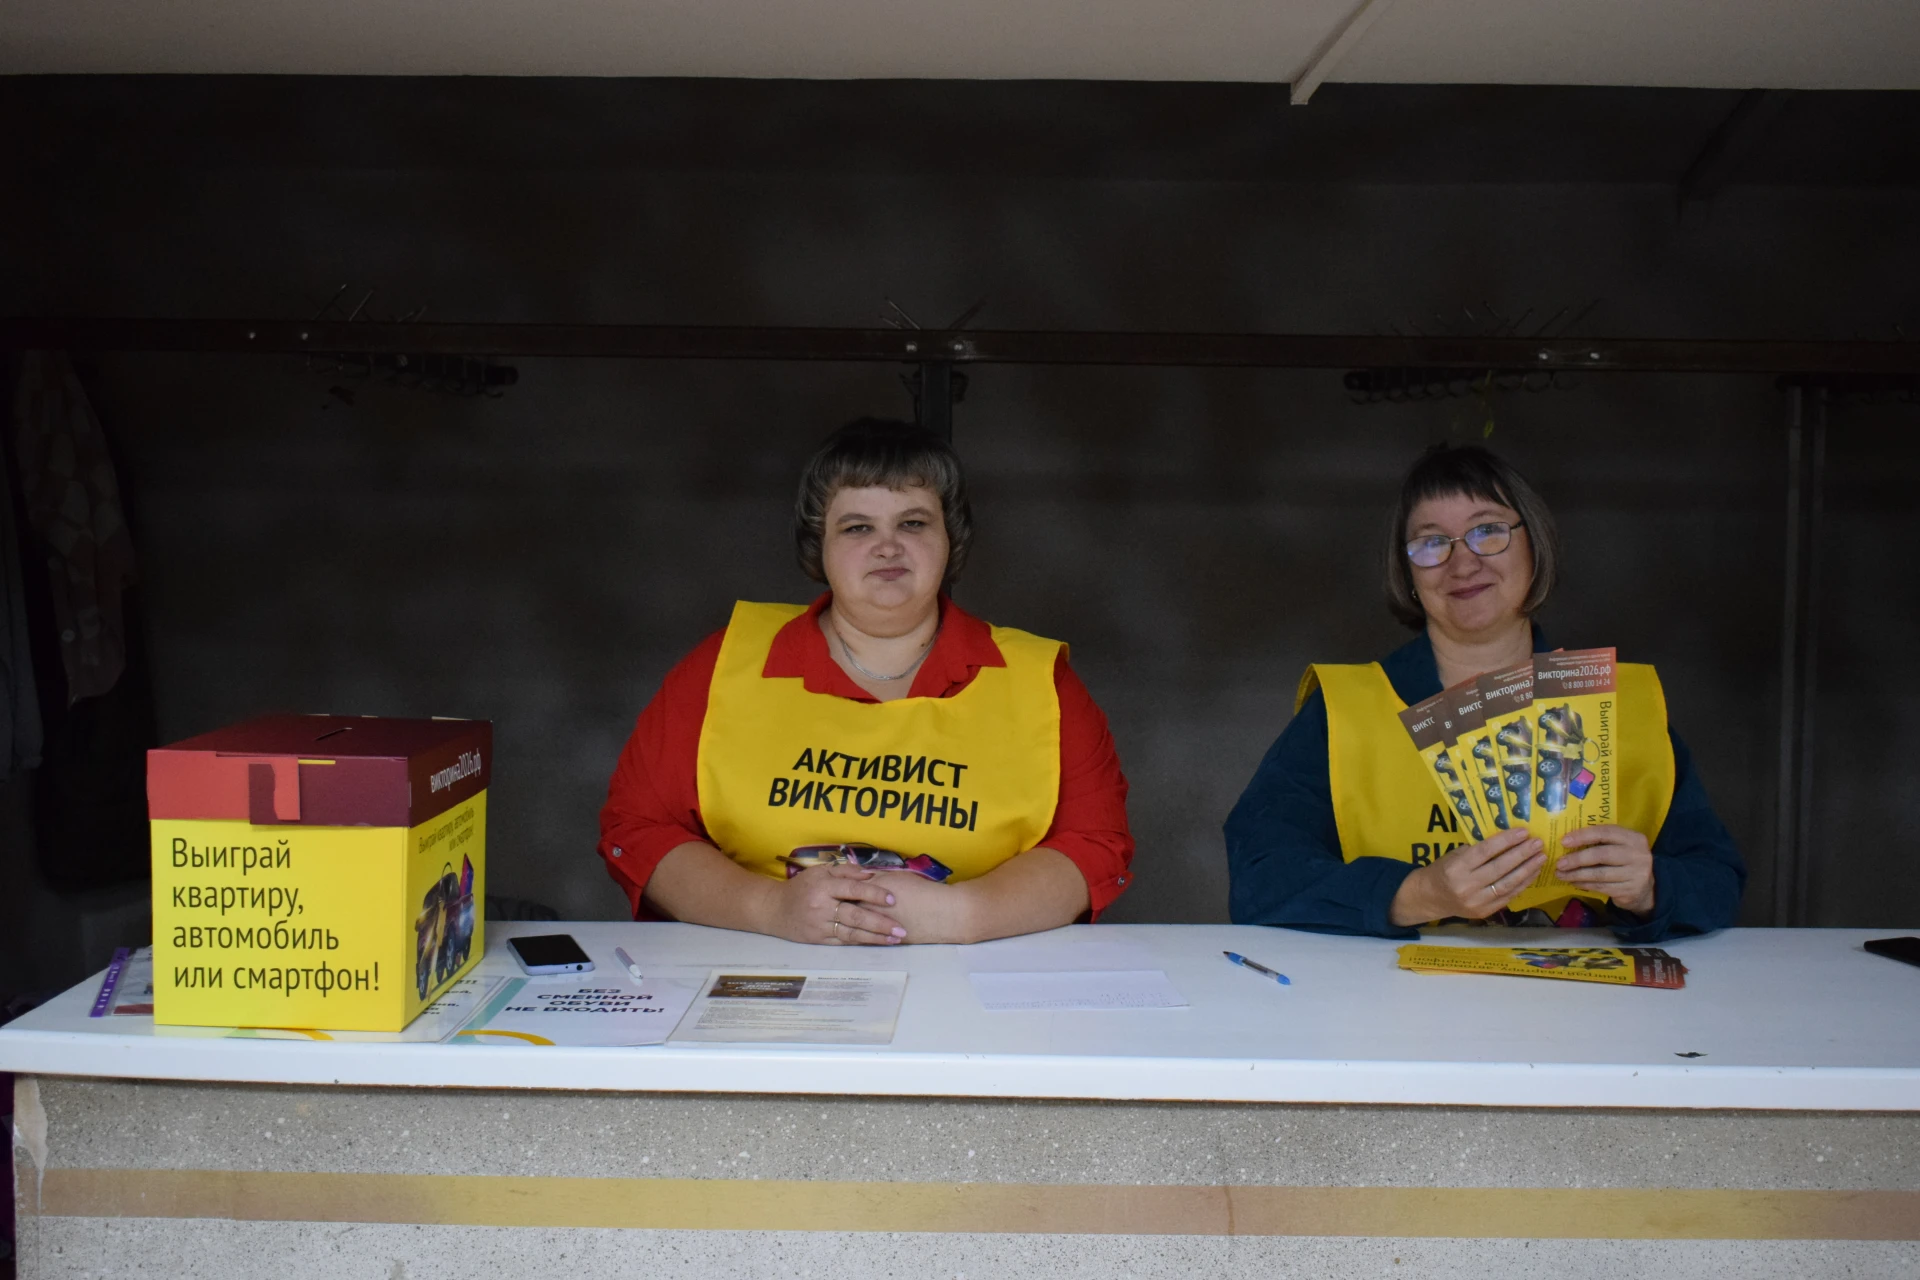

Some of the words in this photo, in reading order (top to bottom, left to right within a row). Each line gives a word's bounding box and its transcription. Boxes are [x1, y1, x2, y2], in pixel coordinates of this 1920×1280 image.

[1485, 675, 1534, 700] викторина2
[1537, 664, 1611, 680] викторина2026.рф
[1458, 700, 1484, 715] викто
[1597, 700, 1612, 757] Выиграй
[792, 747, 968, 789] АКТИВИСТ
[768, 777, 978, 832] ВИКТОРИНЫ
[1598, 762, 1612, 823] квартиру,
[172, 838, 291, 876] Выиграй
[173, 886, 304, 917] квартиру,
[173, 920, 339, 950] автомобиль
[174, 966, 222, 988] или
[233, 960, 380, 997] смартфон!
